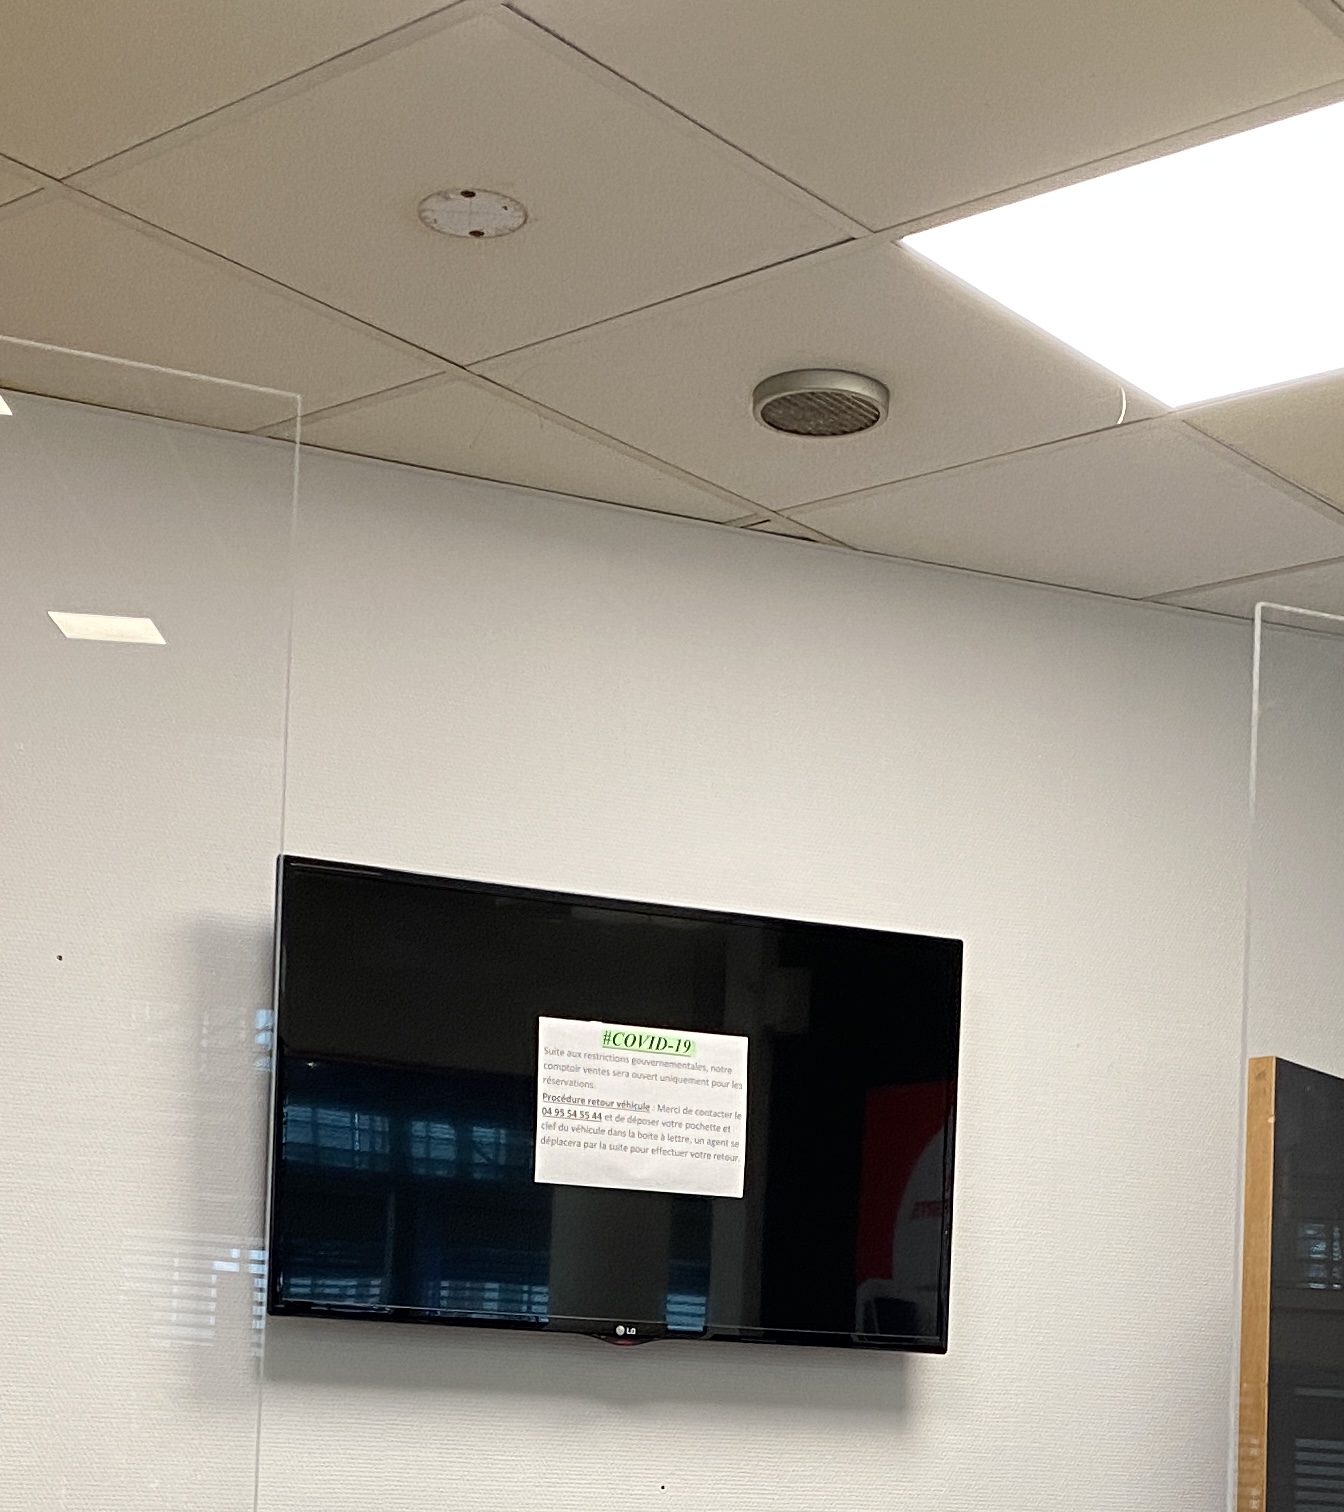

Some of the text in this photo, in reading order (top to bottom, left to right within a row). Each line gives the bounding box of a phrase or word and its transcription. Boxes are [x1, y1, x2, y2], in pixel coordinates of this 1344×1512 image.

[603, 1030, 691, 1054] #COVID-19
[544, 1046, 565, 1056] Suite
[567, 1050, 582, 1059] aux
[584, 1051, 629, 1064] restrictions
[711, 1065, 732, 1075] notre
[544, 1062, 743, 1090] comptoir ventes sera ouvert uniquement pour les
[543, 1092, 742, 1120] Procédure retour véhicule Merci de contacter le
[542, 1107, 731, 1134] 04 95 54 55 44 et de déposer votre pochette et
[541, 1121, 556, 1131] clef
[558, 1123, 569, 1132] du
[571, 1125, 606, 1136] véhicule
[608, 1128, 626, 1139] dans
[629, 1129, 636, 1139] la
[667, 1133, 692, 1145] lettre,
[694, 1137, 705, 1145] un
[707, 1138, 728, 1148] agent
[731, 1140, 740, 1149] se
[541, 1136, 581, 1148] déplacera
[583, 1141, 597, 1151] par
[599, 1140, 607, 1150] la
[609, 1142, 628, 1153] suite
[630, 1146, 649, 1155] pour
[651, 1146, 688, 1158] effectuer
[690, 1150, 711, 1160] votre
